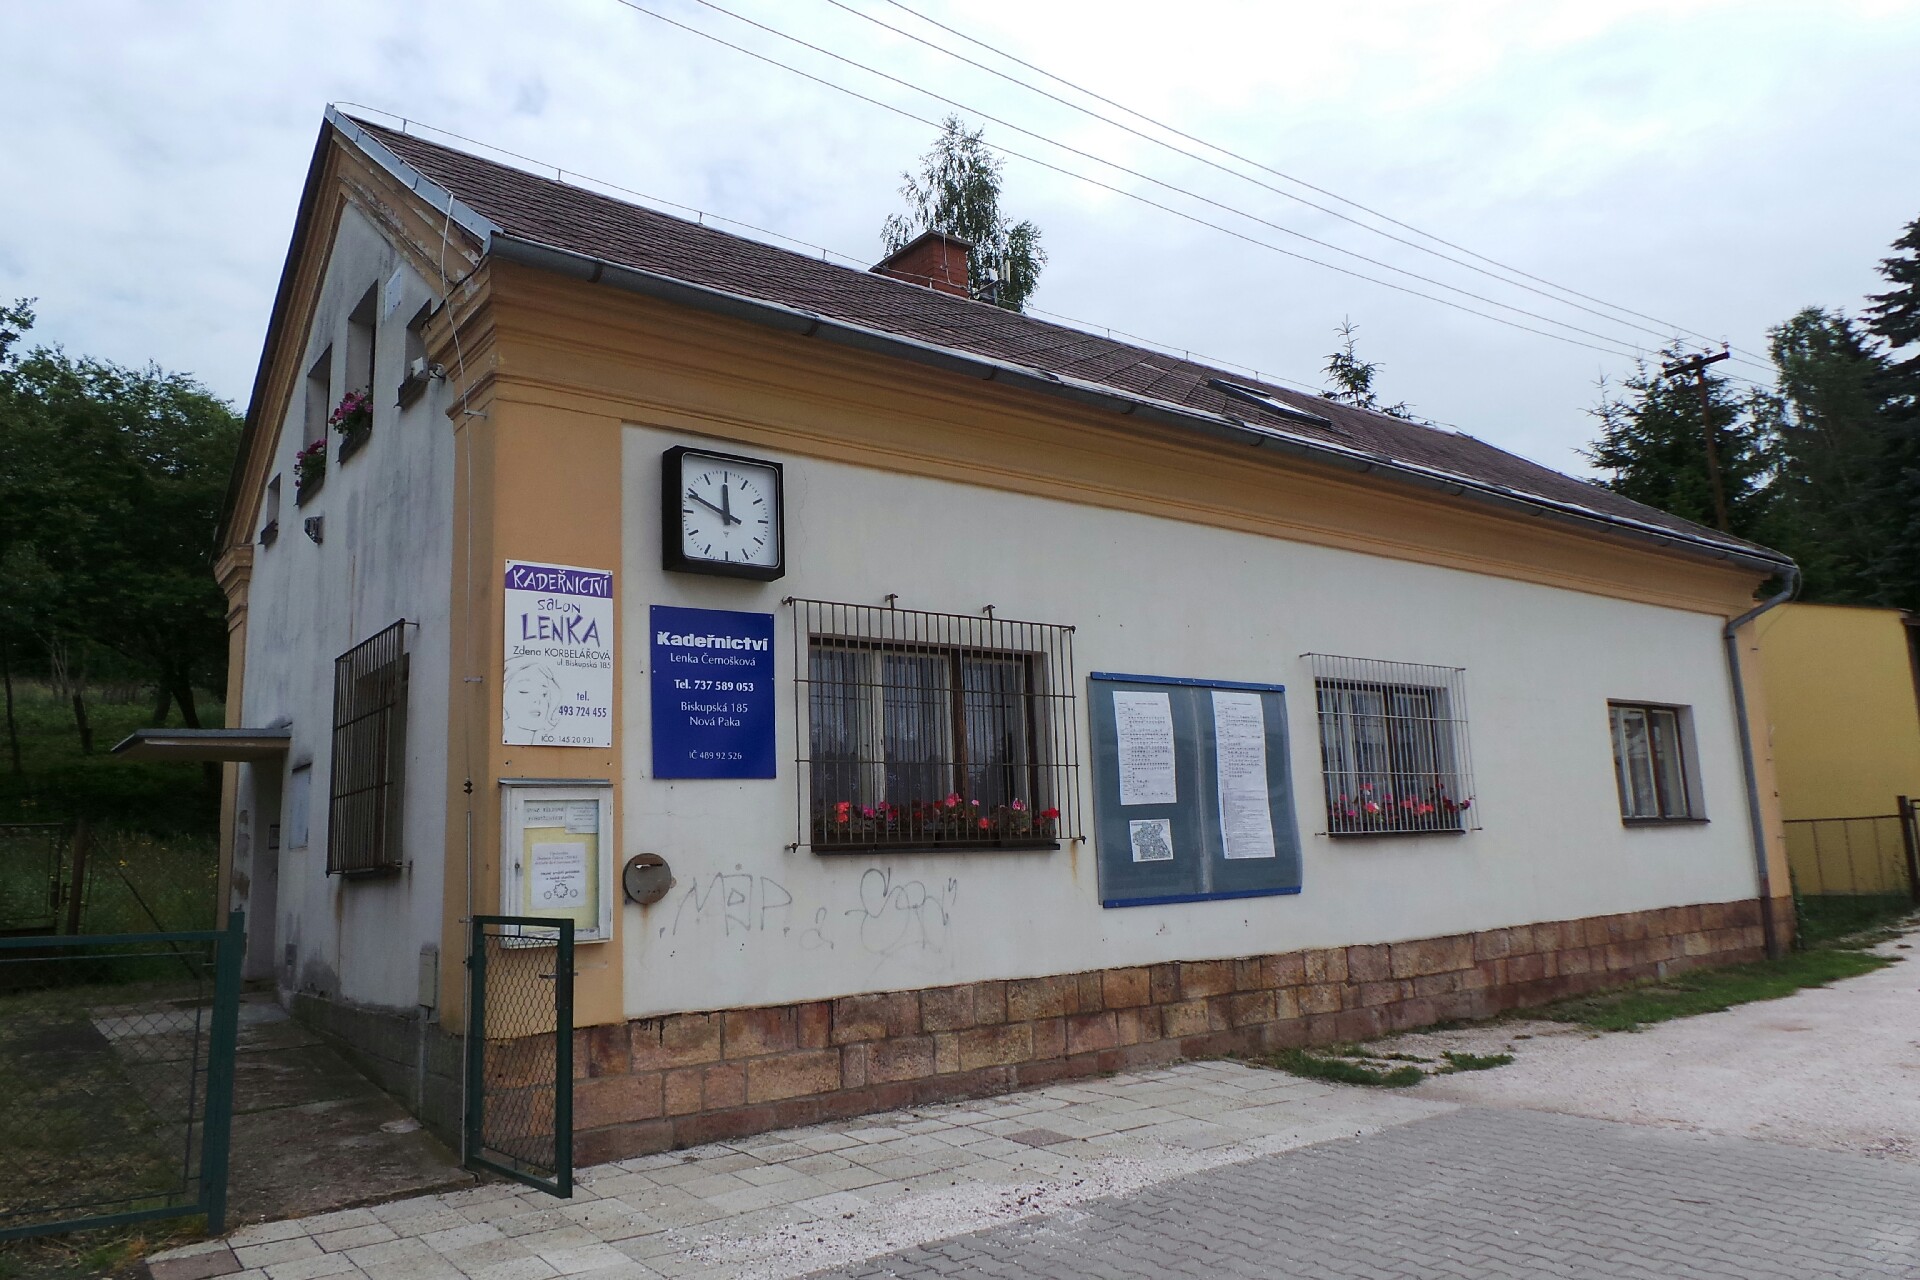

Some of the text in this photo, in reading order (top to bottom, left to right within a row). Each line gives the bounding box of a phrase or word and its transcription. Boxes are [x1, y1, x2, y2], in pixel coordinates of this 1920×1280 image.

[513, 568, 610, 596] KADEŘNICTVÍ
[521, 613, 601, 648] LENKA
[656, 631, 769, 651] Kadeřnictví
[544, 647, 611, 660] KORBELÁŘOVÁ
[670, 652, 756, 666] Lenka Černošková
[565, 660, 598, 669] Biskupská
[599, 661, 611, 669] 185
[674, 679, 754, 692] Tel. 737 589 053
[576, 691, 590, 701] tel.
[558, 705, 607, 718] 493 724 455
[681, 701, 748, 714] Biskupská 185
[689, 716, 740, 727] Nová Paka
[689, 749, 742, 760] IČ 489 92 526
